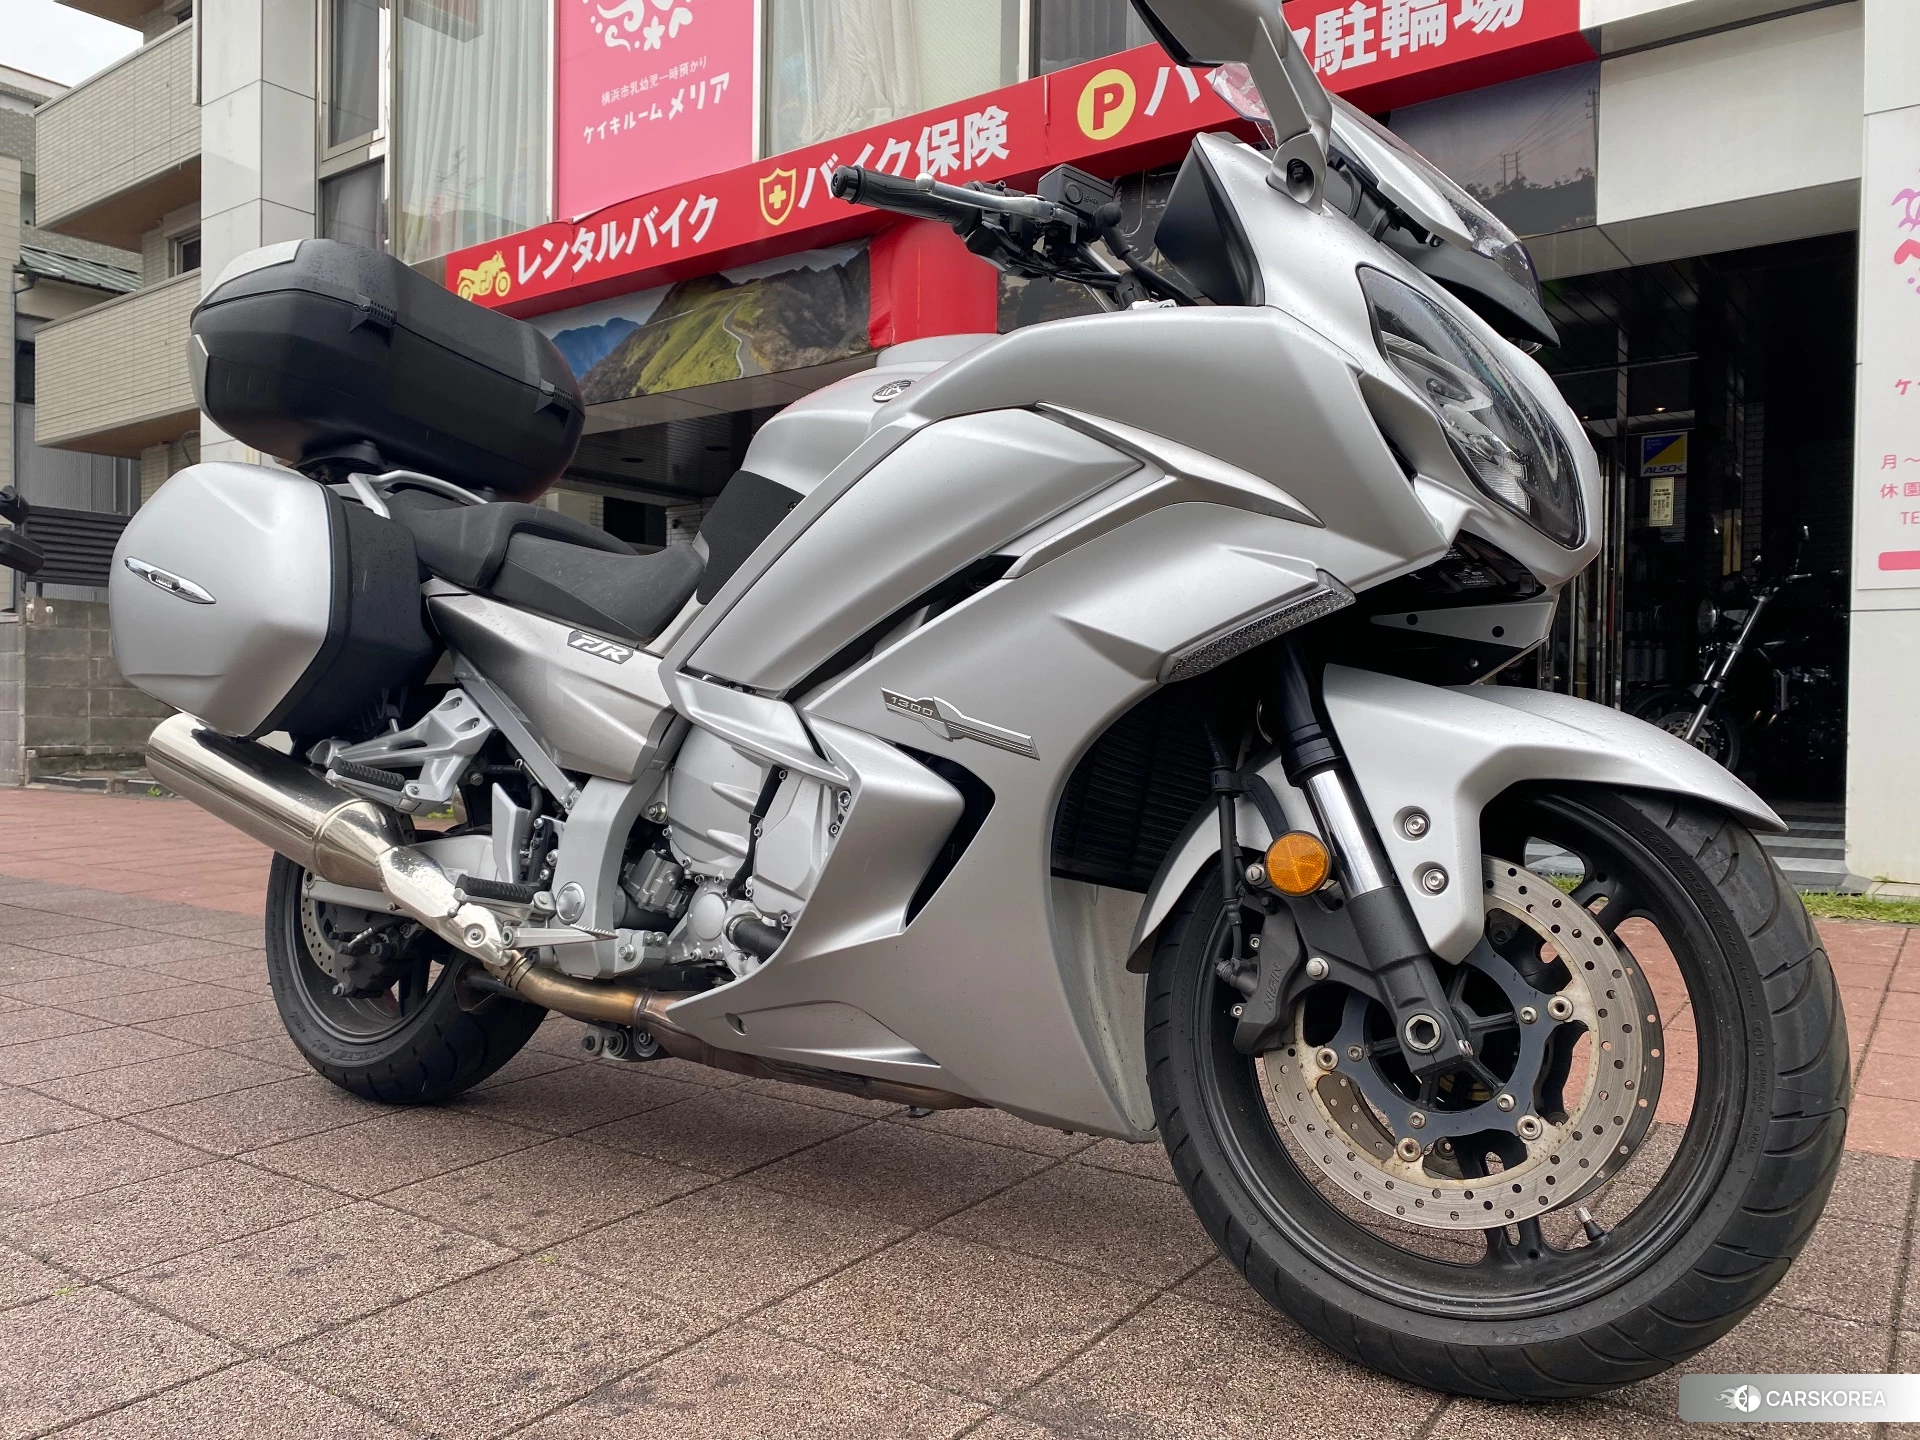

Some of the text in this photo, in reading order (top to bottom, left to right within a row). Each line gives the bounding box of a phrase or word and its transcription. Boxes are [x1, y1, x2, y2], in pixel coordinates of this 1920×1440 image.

[583, 72, 730, 144] ケイキルーム メリア
[797, 105, 1010, 209] バイク保険
[517, 193, 719, 286] レンタルバイク
[1894, 378, 1920, 396] ケ
[1643, 464, 1684, 475] ALSOK
[569, 634, 630, 662] FJR
[890, 696, 934, 718] 1300
